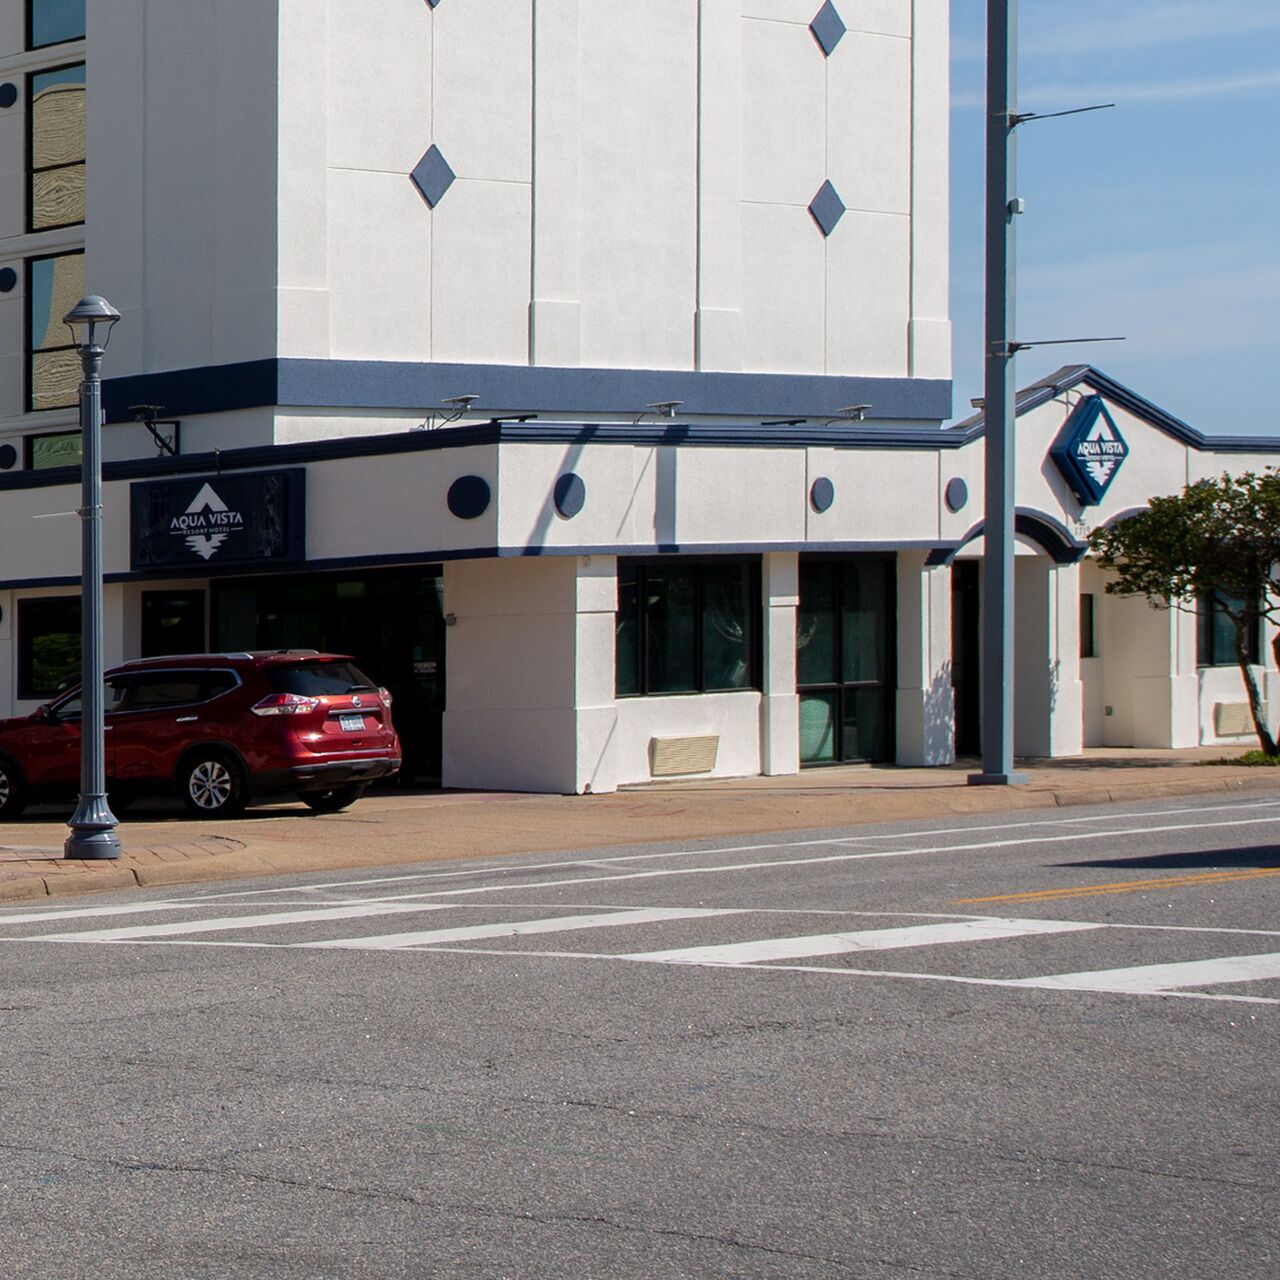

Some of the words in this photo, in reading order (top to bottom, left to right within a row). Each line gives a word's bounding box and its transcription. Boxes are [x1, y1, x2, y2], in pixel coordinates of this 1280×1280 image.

[1077, 441, 1101, 456] AQUA
[1101, 441, 1124, 455] VISTA
[170, 514, 207, 530] AQUA
[208, 512, 243, 525] VISTA
